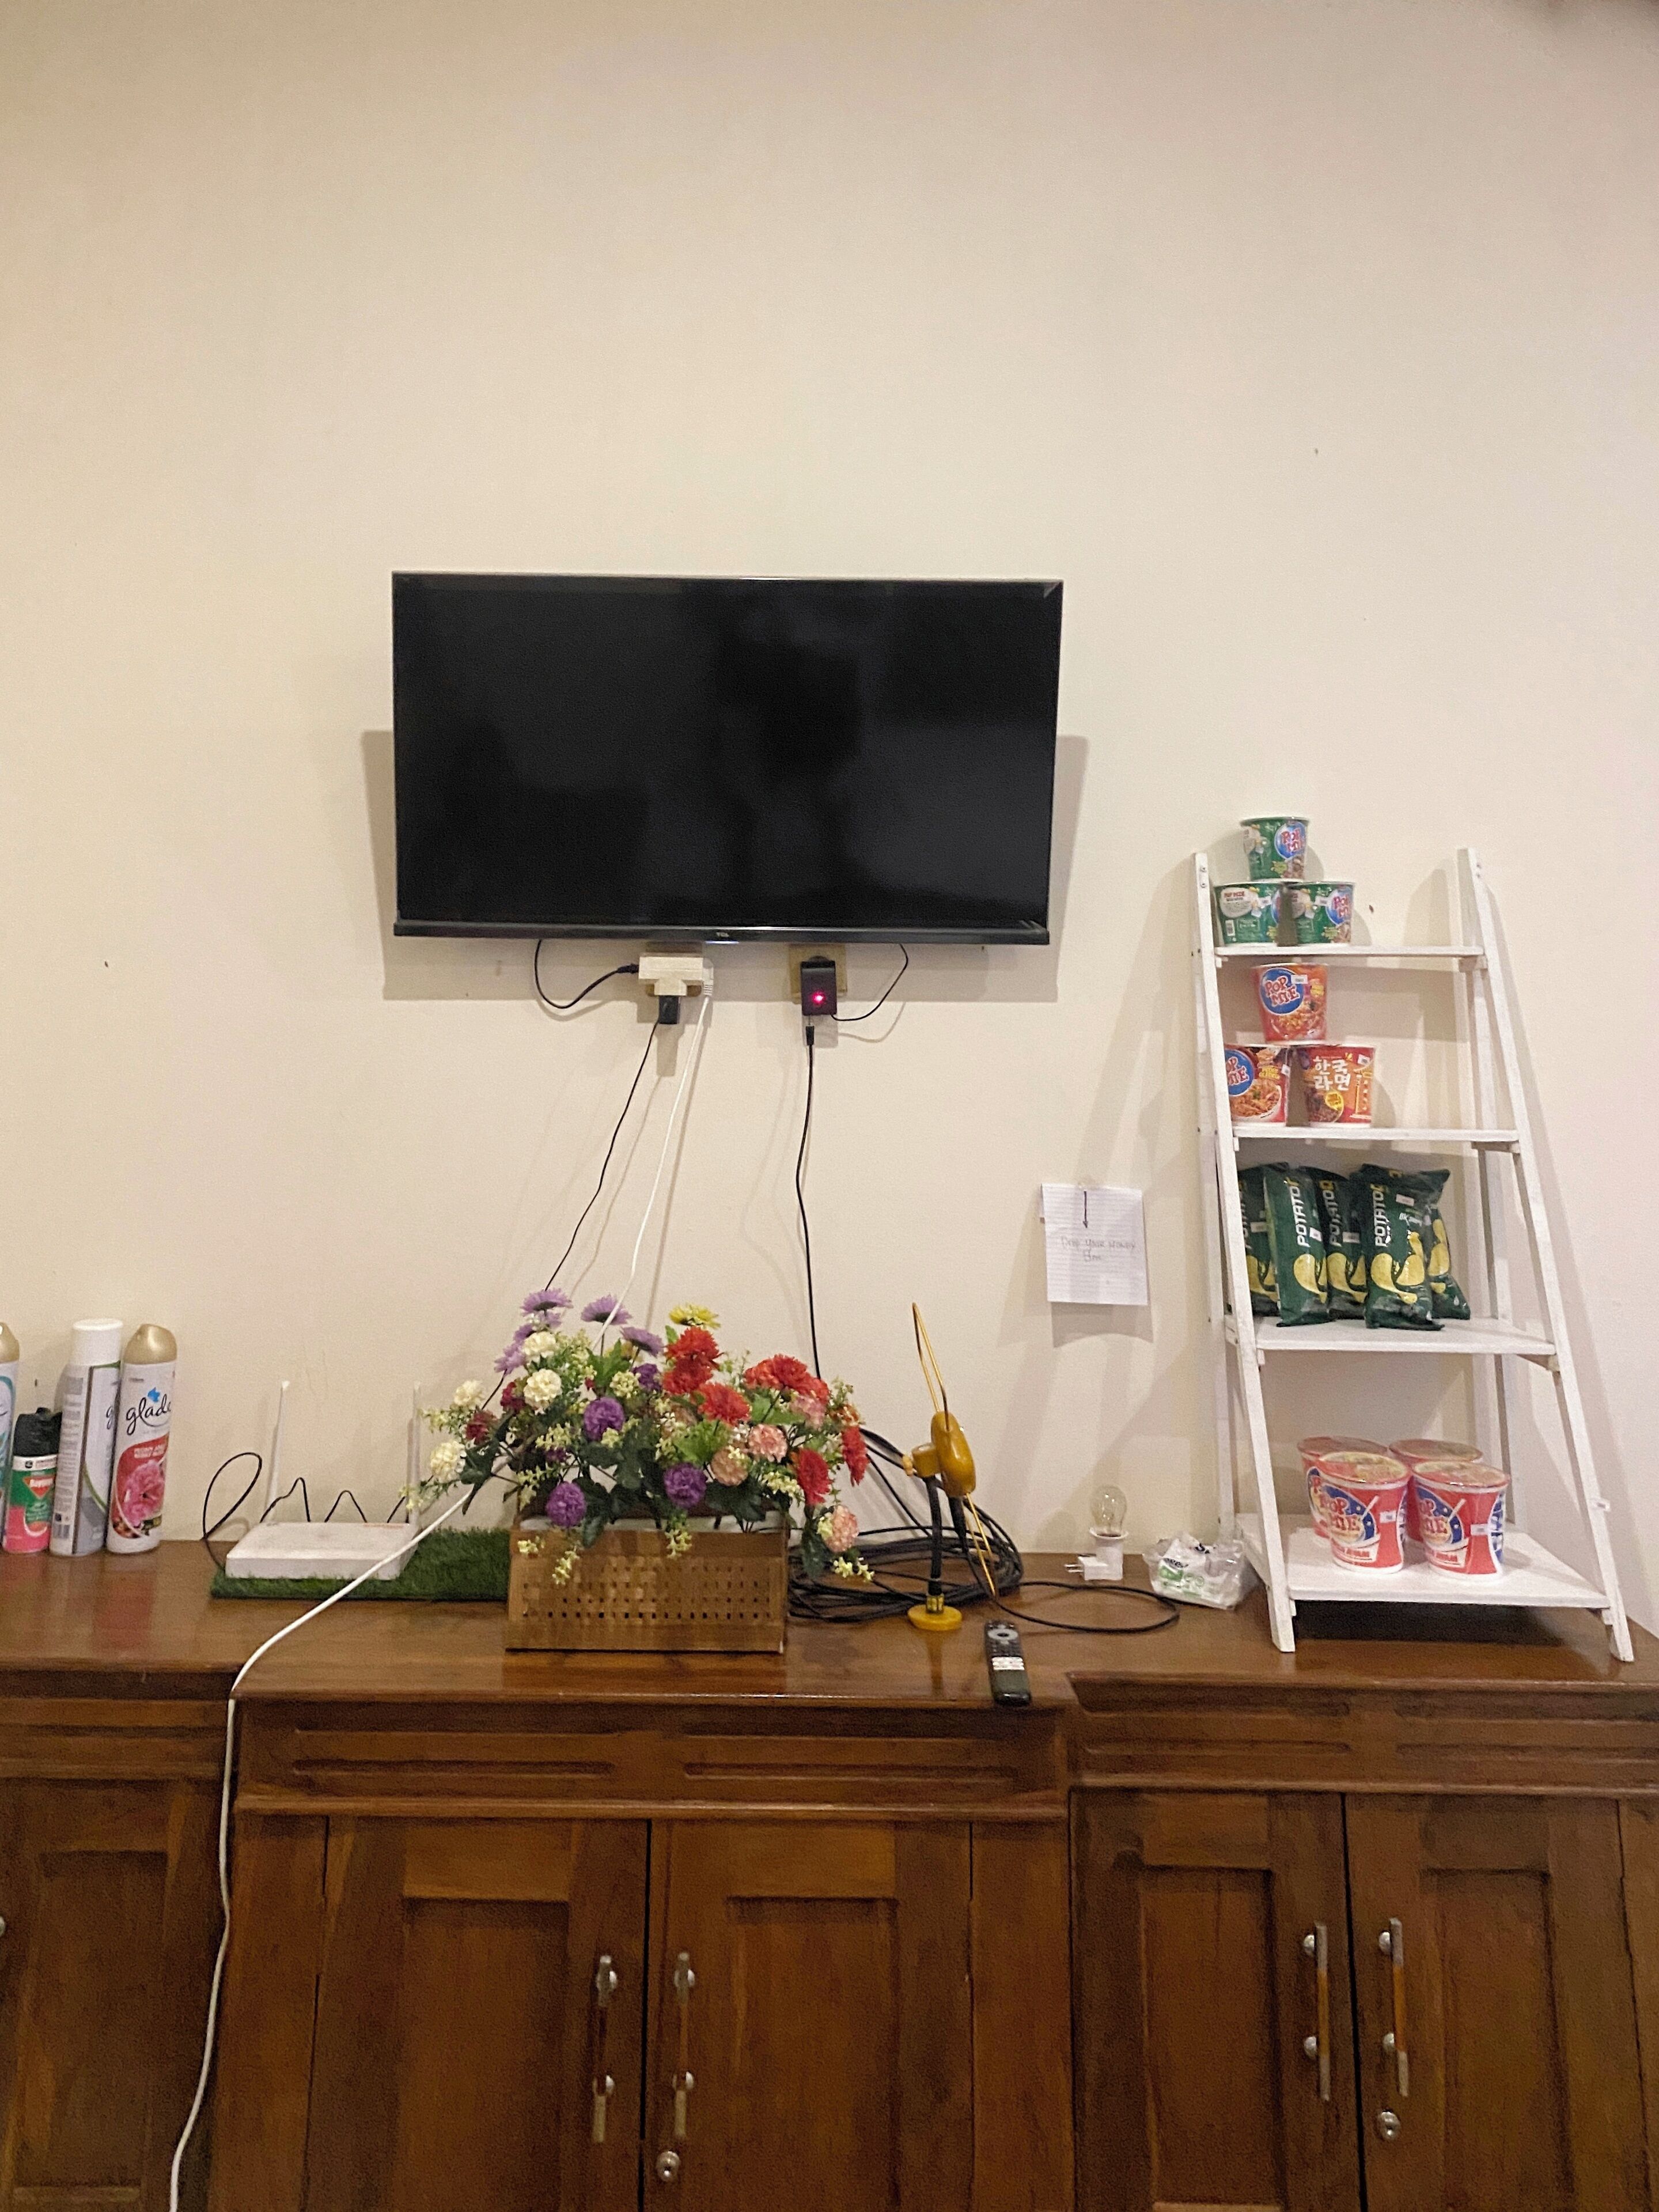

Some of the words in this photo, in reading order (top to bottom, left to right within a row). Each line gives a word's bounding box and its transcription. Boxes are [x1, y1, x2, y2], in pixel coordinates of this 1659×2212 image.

[1264, 976, 1288, 997] POP
[1270, 984, 1300, 1007] MIE
[1290, 1185, 1310, 1248] POTATO
[1373, 1190, 1389, 1247] POTATO
